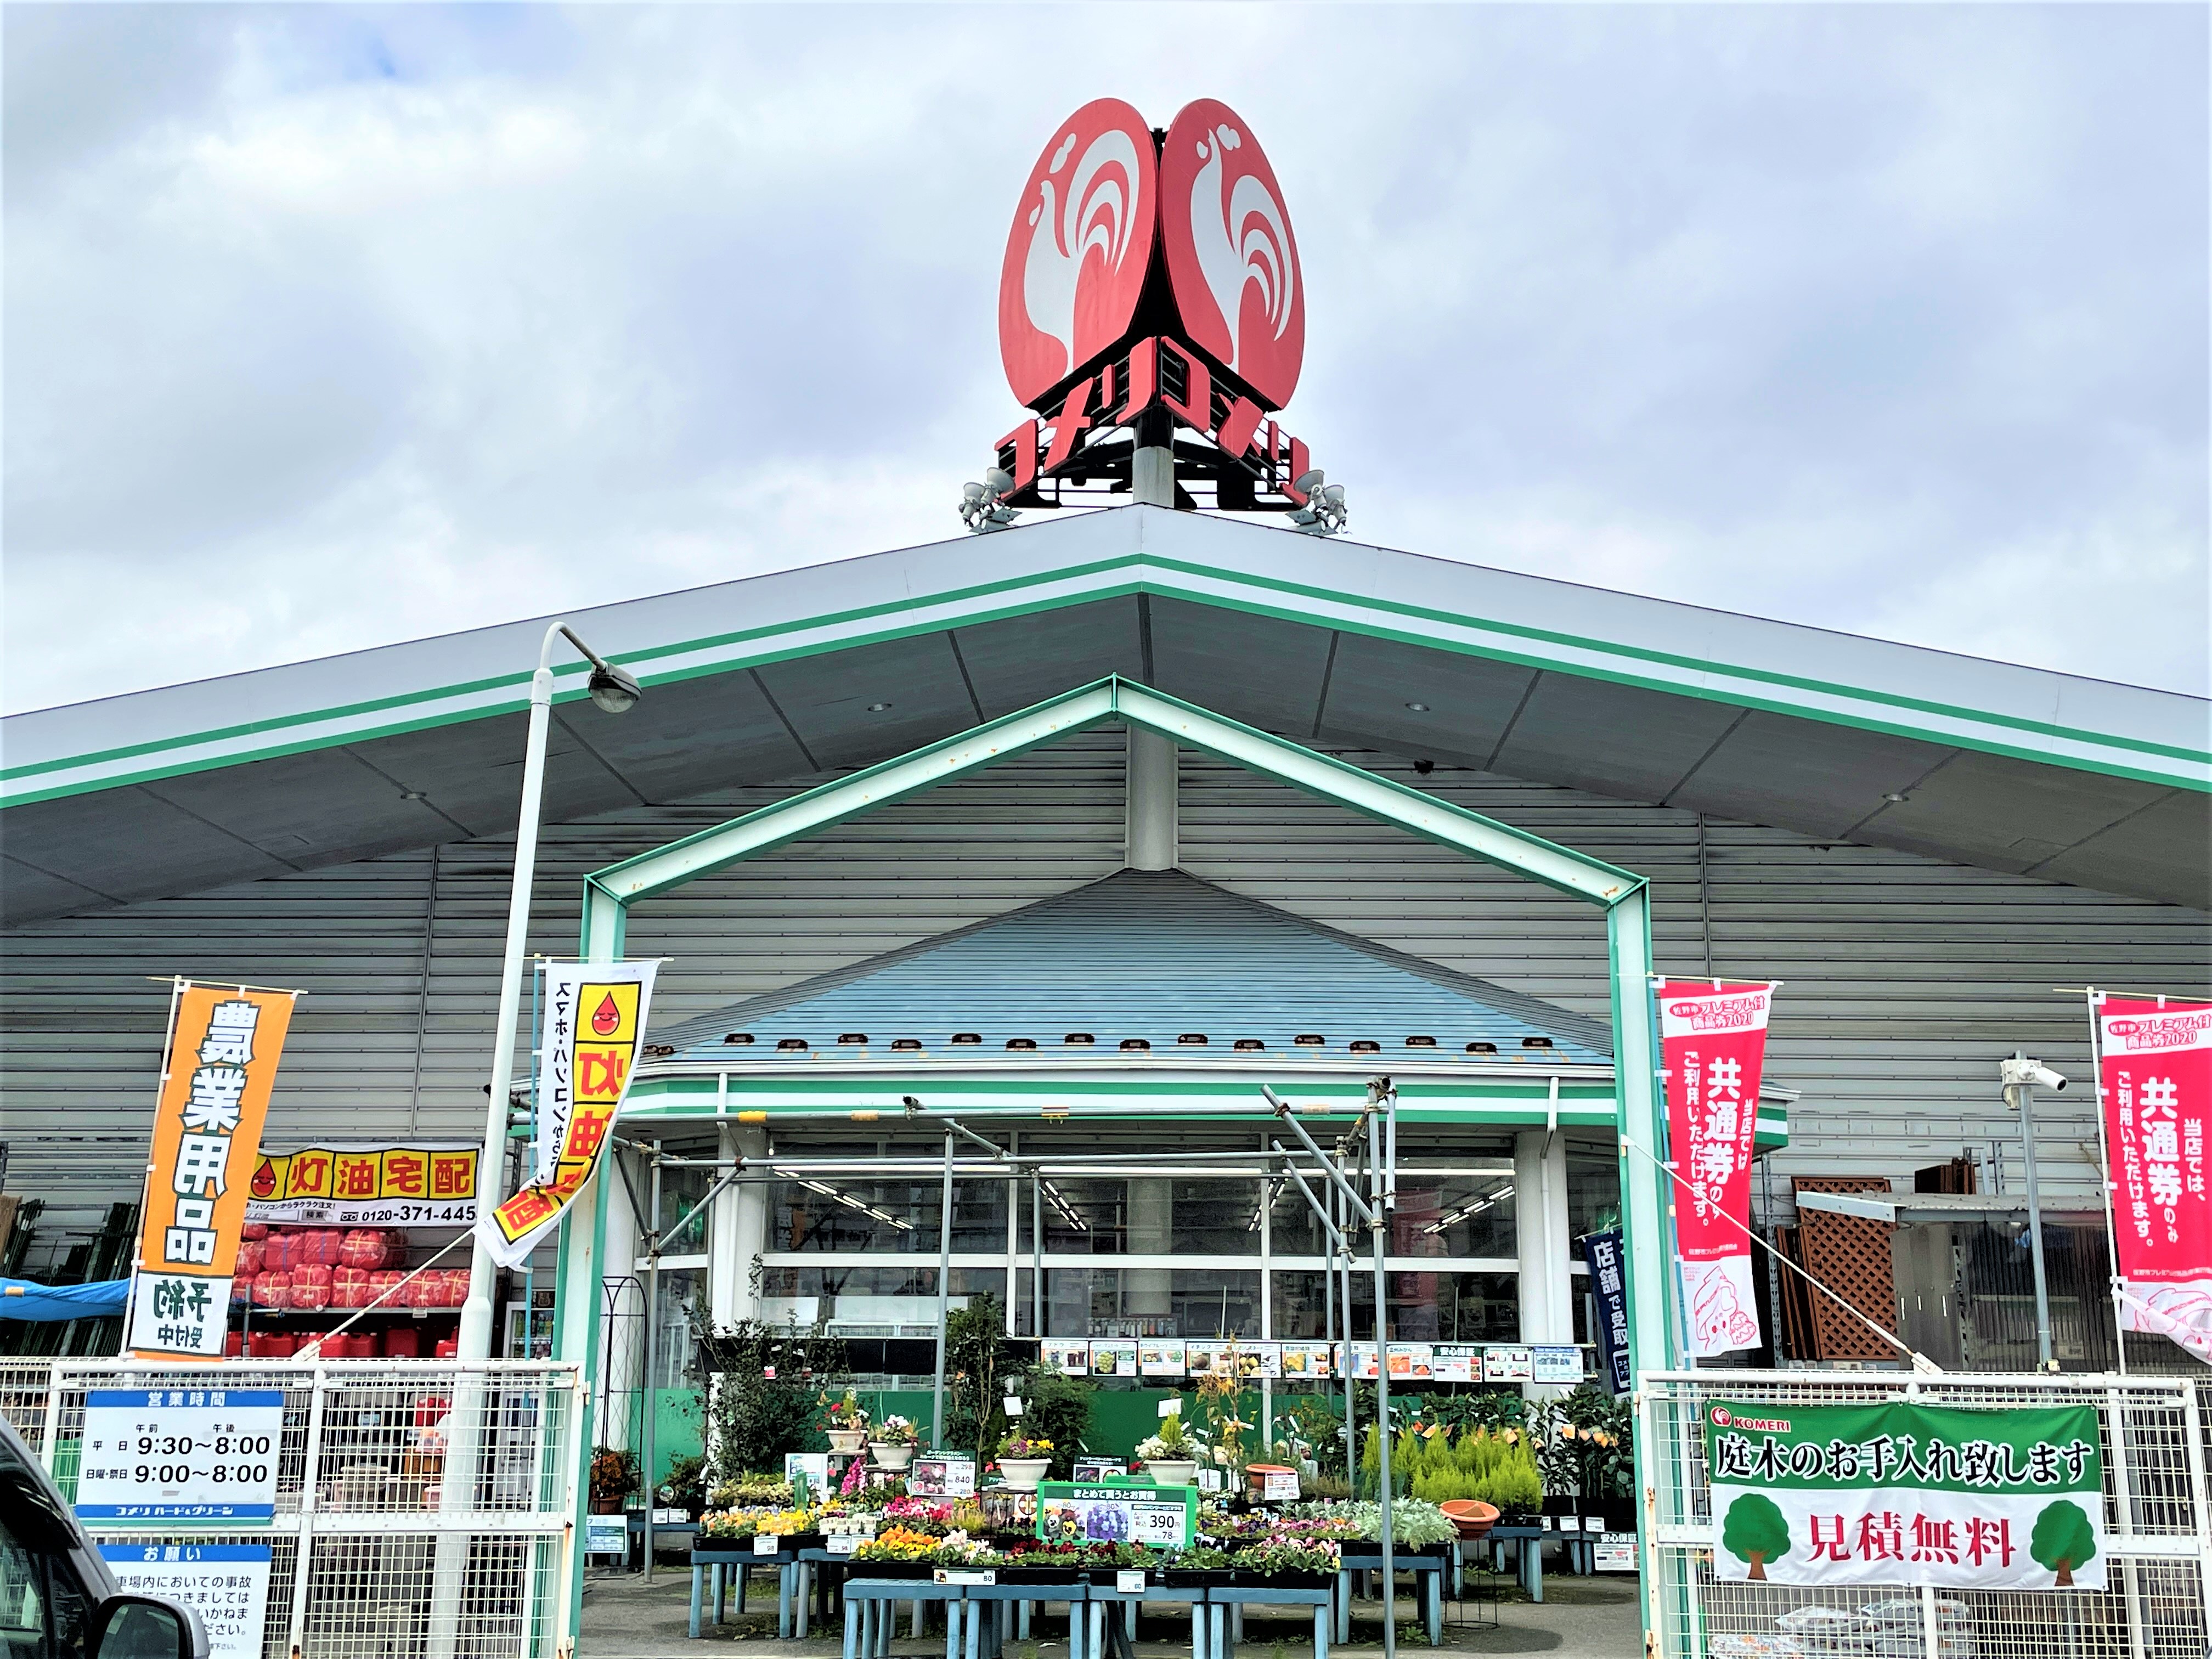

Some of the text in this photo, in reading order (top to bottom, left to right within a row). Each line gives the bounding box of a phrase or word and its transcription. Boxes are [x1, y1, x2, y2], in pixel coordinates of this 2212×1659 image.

[994, 336, 1158, 504] コメリ
[1160, 336, 1310, 507] コメリ
[2117, 1071, 2154, 1247] ご利用いただけます。
[290, 1155, 471, 1195] 灯油宅配
[362, 1205, 476, 1221] 0120-371-445
[148, 1391, 226, 1407] 営業時間
[136, 1424, 235, 1434] 午前 午後
[1734, 1417, 1791, 1432] KOMERI
[1714, 1434, 2095, 1487] 庭木のお手入れ致します
[116, 1506, 151, 1516] コメリ
[144, 1546, 201, 1562] お願い
[1805, 1512, 2017, 1568] 見積無料
